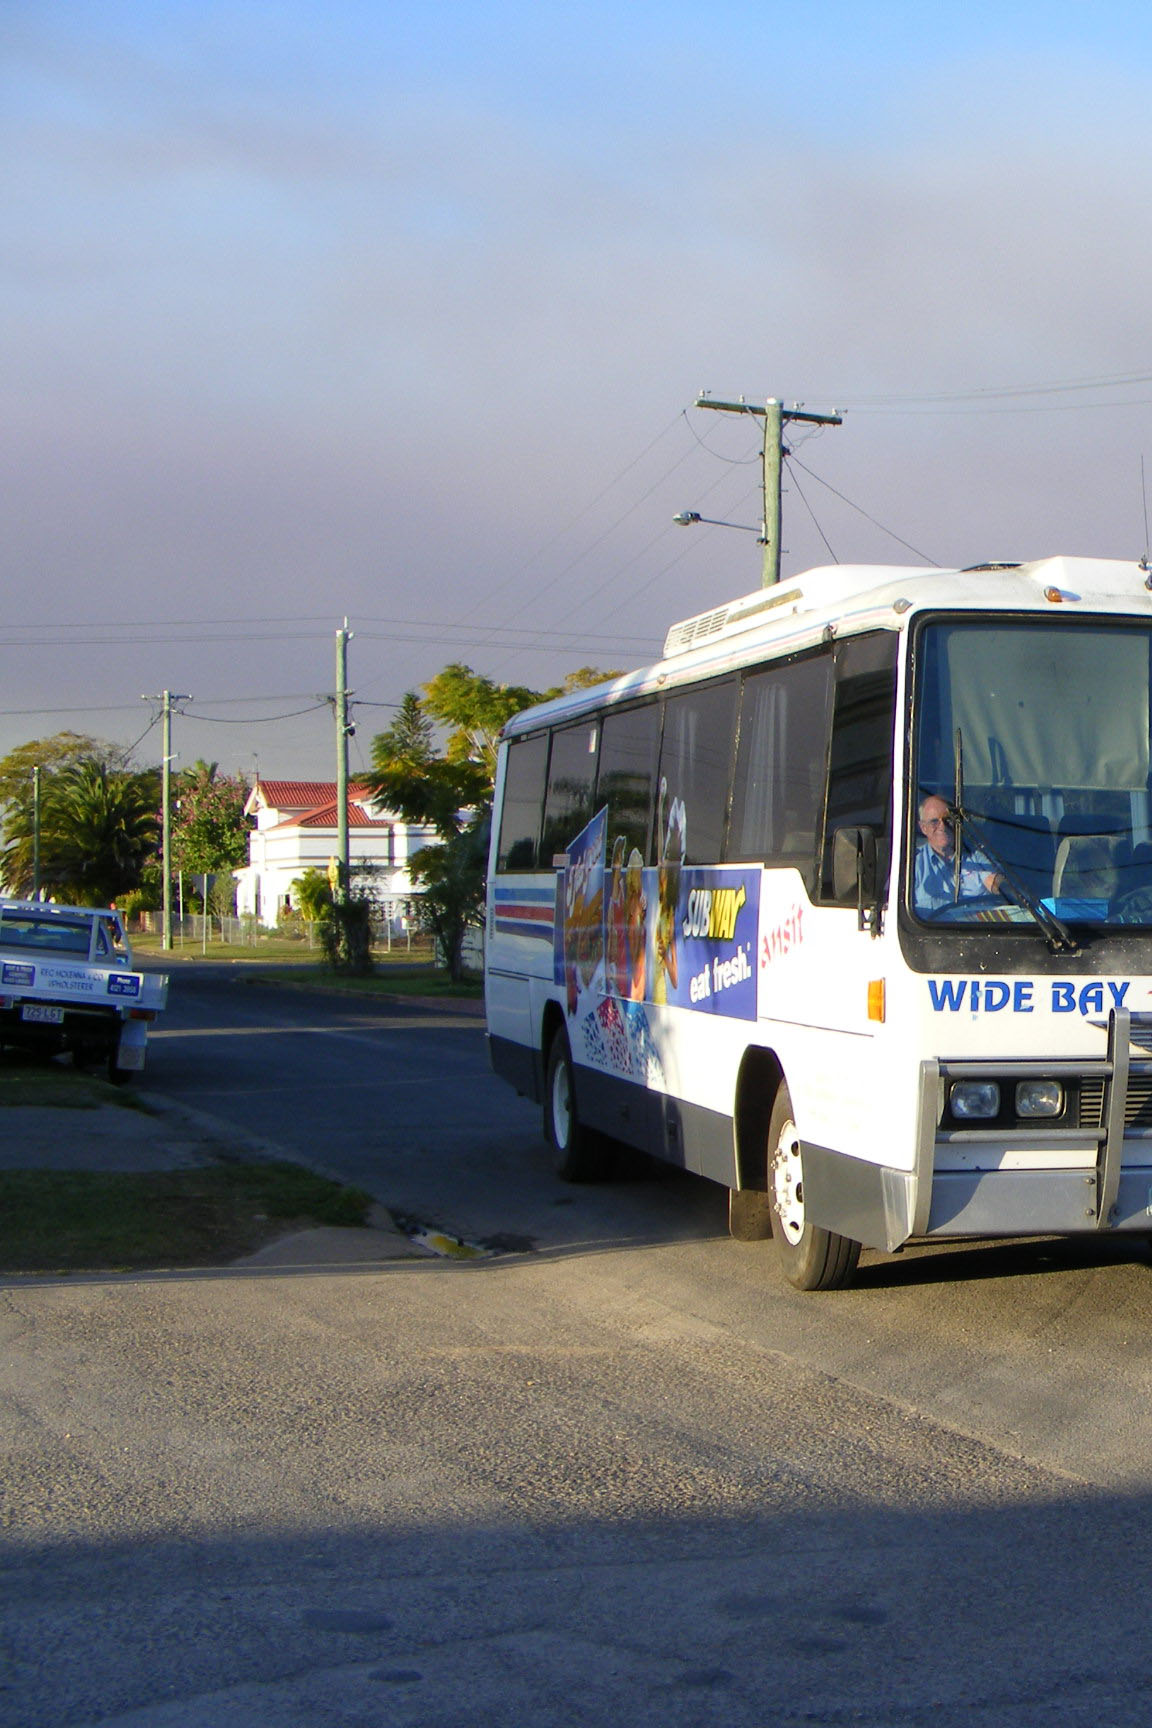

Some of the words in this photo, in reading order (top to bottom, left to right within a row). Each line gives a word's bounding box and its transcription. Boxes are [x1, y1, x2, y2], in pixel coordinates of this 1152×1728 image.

[683, 885, 746, 938] SUBWAY
[690, 963, 711, 1003] eat
[928, 980, 1034, 1012] WIDE
[1051, 982, 1130, 1016] BAY
